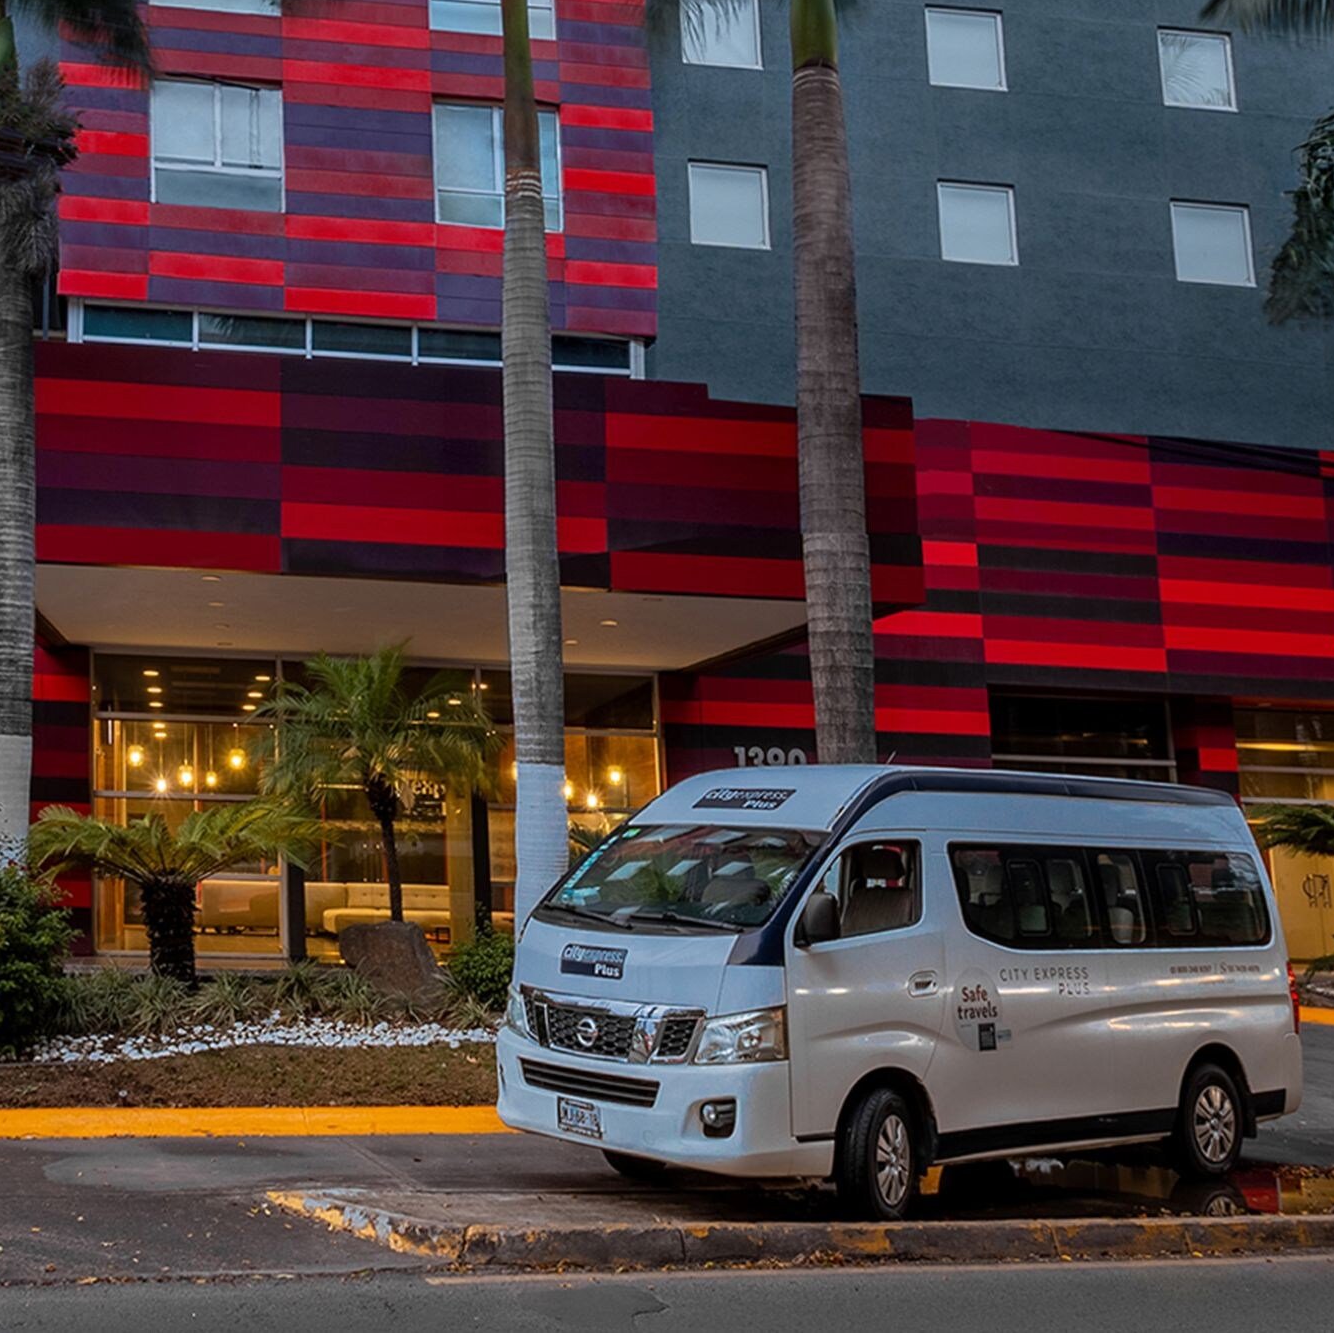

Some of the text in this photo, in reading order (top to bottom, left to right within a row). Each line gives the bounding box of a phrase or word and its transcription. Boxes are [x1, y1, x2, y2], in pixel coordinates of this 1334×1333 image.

[742, 800, 778, 809] Plus
[594, 963, 620, 977] Plus
[999, 966, 1089, 982] CITY EXPRESS
[962, 984, 988, 1002] Safe
[1058, 982, 1090, 995] PLUS
[957, 1001, 998, 1019] travels
